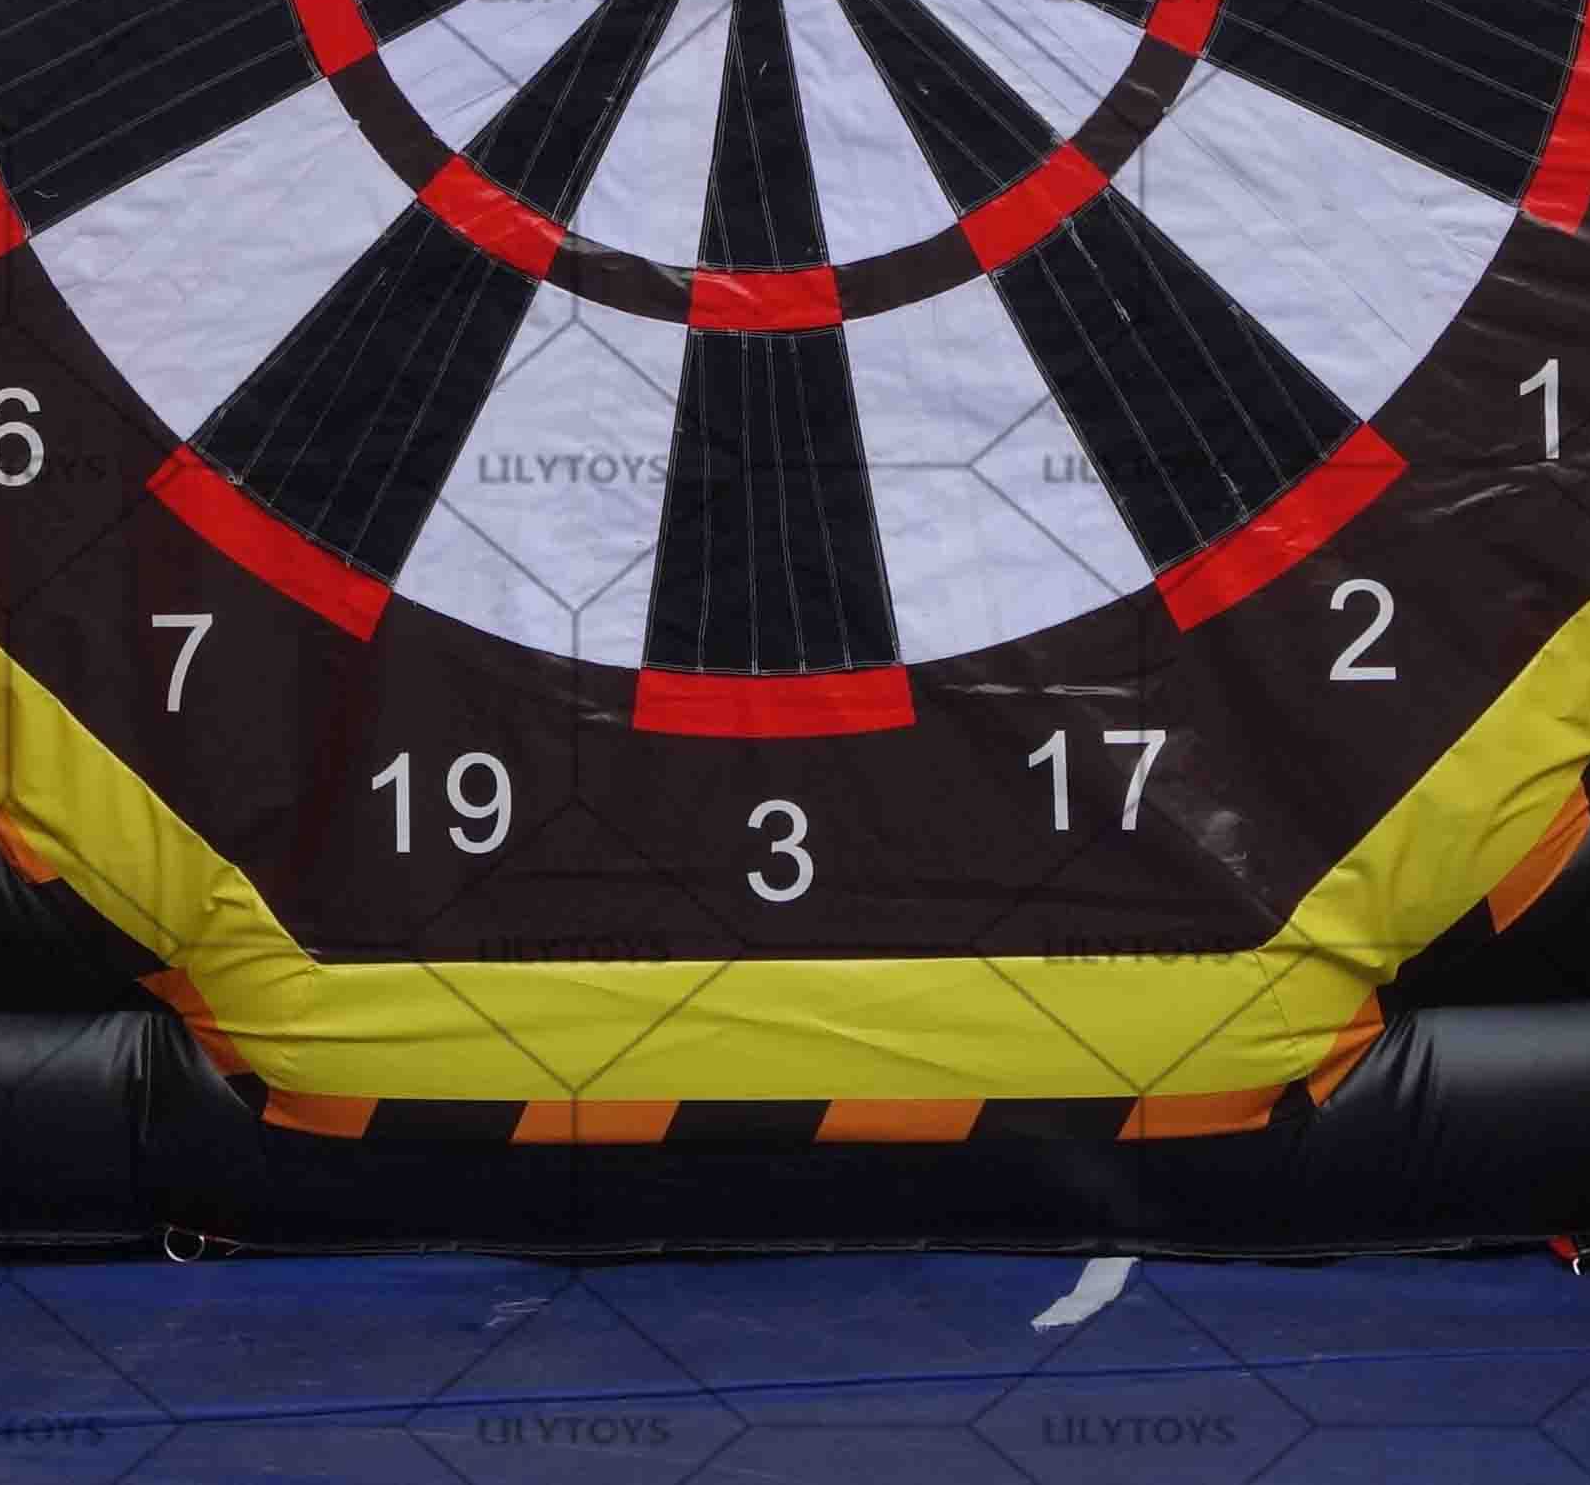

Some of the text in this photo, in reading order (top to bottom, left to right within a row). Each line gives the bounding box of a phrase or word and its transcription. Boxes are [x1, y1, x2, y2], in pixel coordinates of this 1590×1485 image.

[150, 612, 214, 713] 7
[1328, 577, 1398, 682] 2
[370, 751, 513, 855] 19
[1027, 728, 1168, 832] 17
[746, 798, 815, 903] 3
